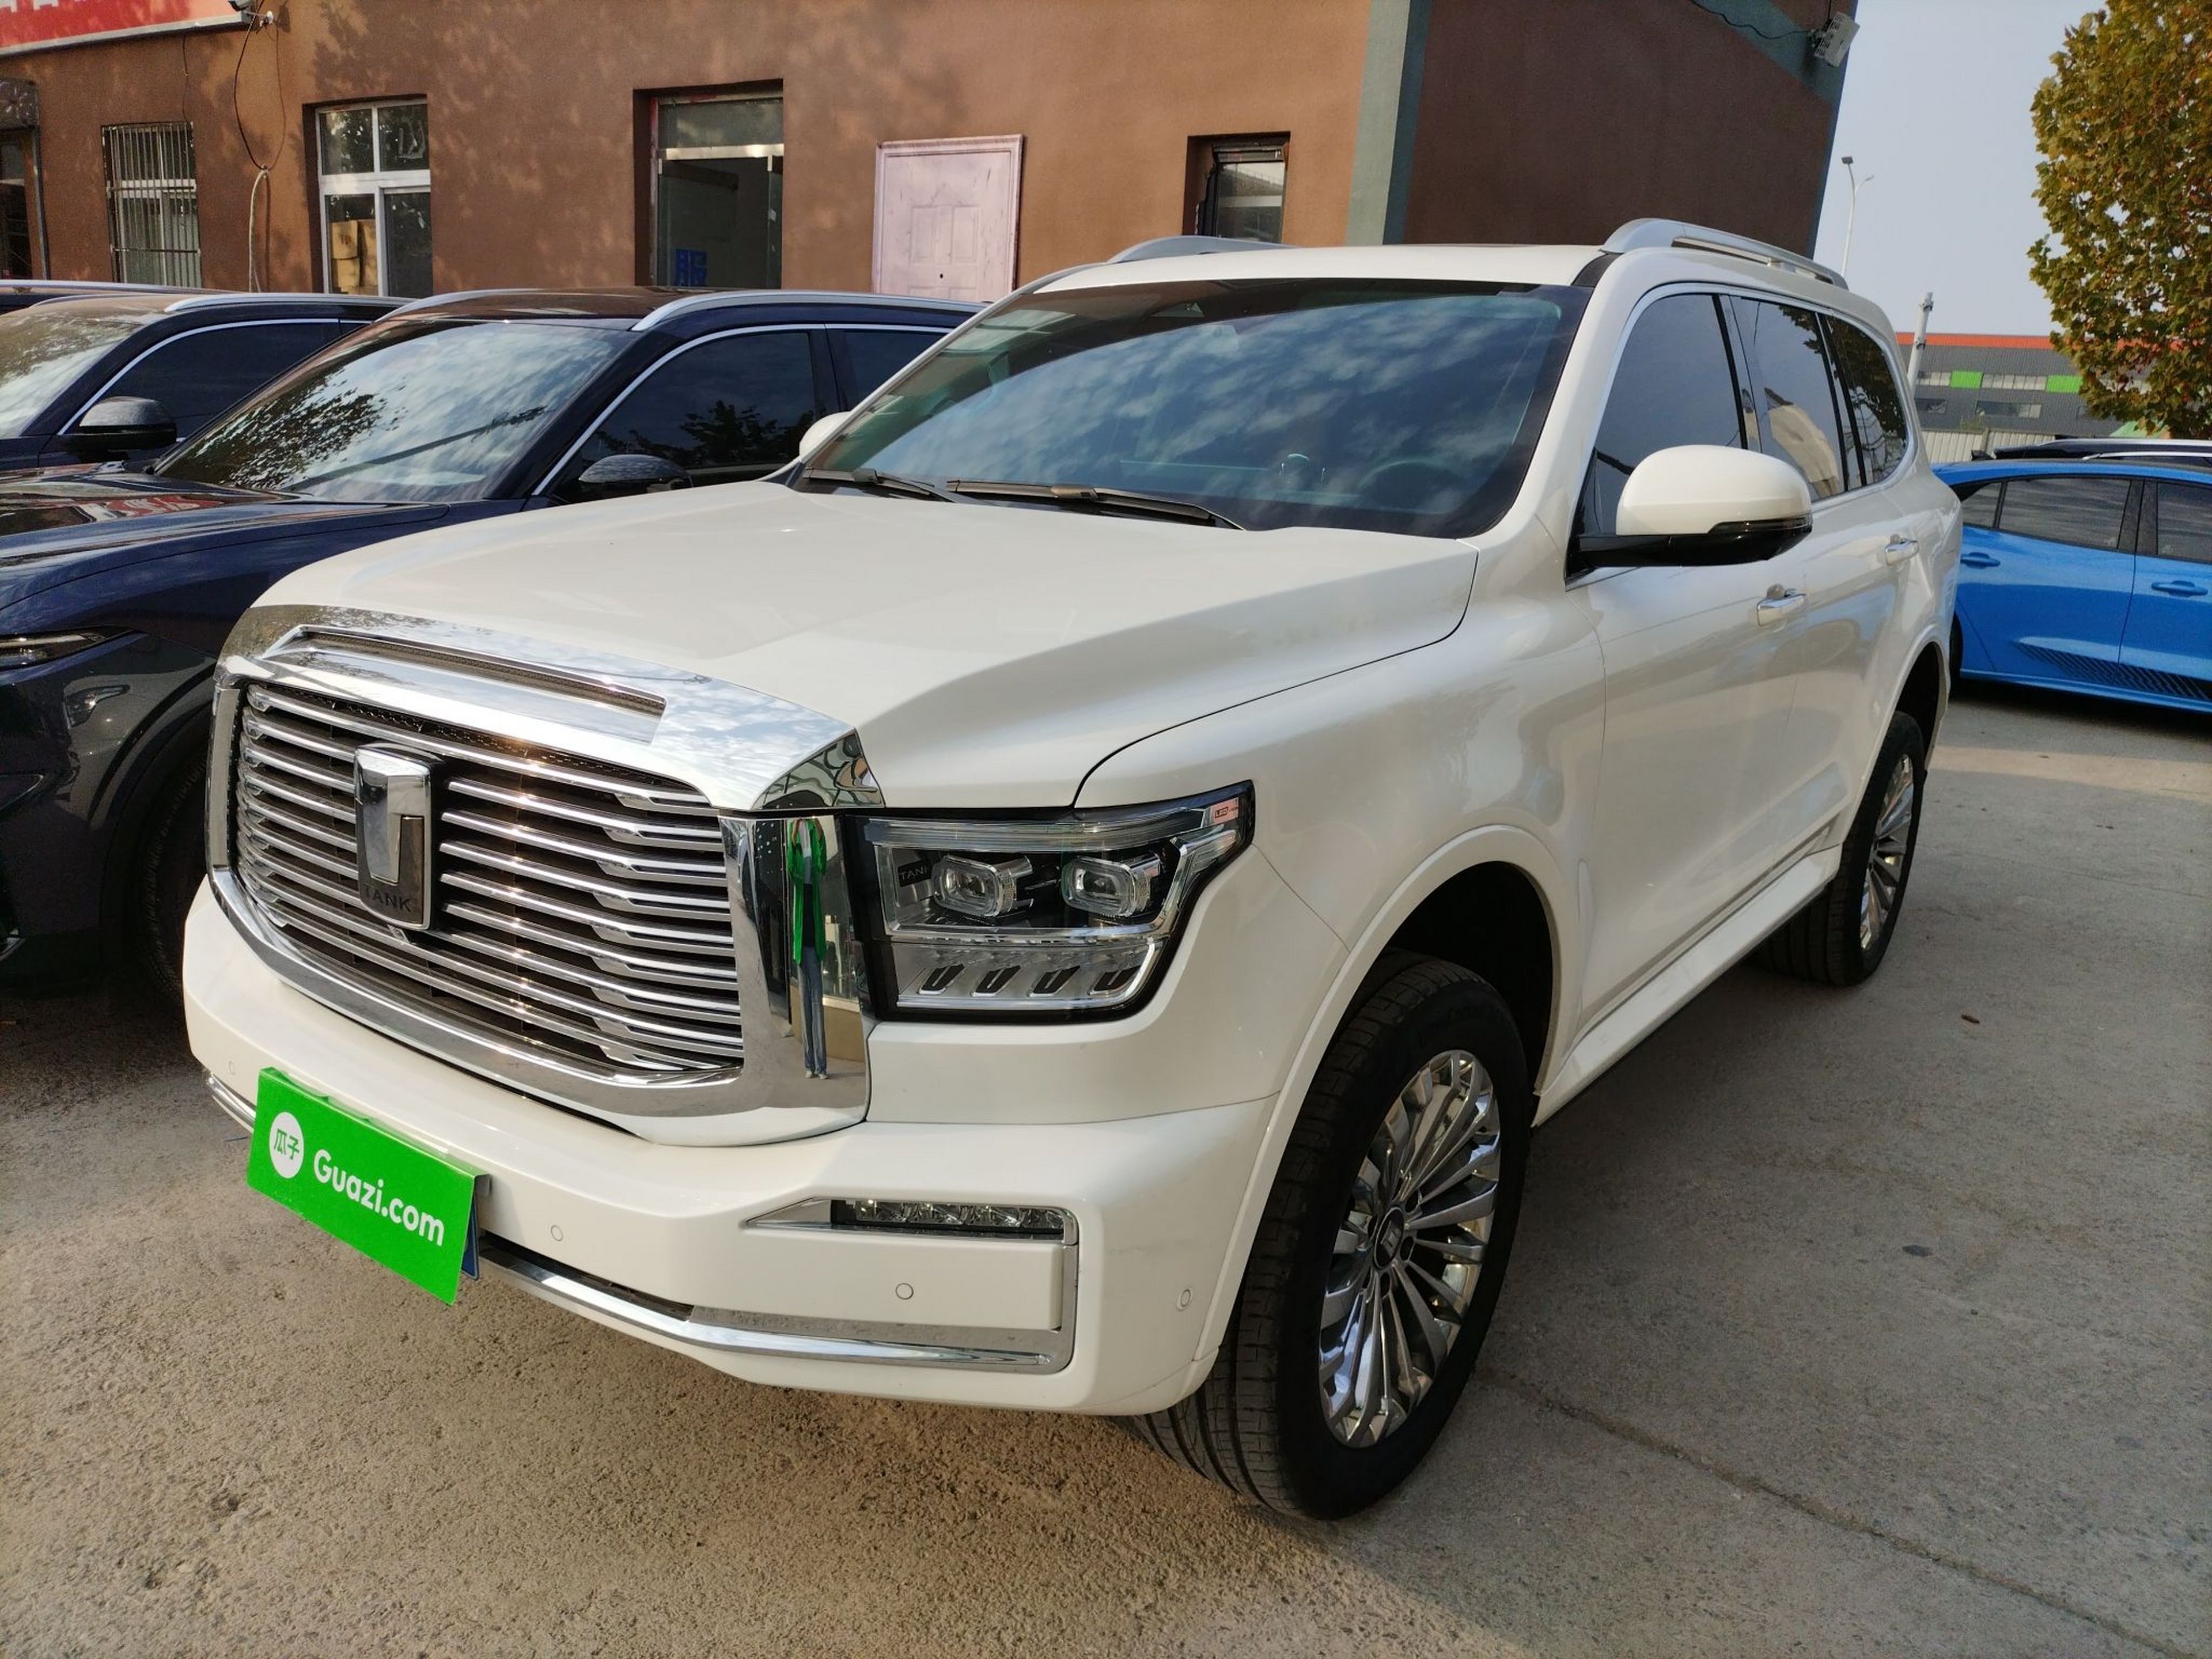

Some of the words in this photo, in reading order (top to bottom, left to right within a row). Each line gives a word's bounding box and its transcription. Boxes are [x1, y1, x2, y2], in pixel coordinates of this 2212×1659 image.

[362, 882, 411, 912] TANK
[274, 1128, 300, 1160] 瓜子
[314, 1149, 445, 1246] Guazi.com
